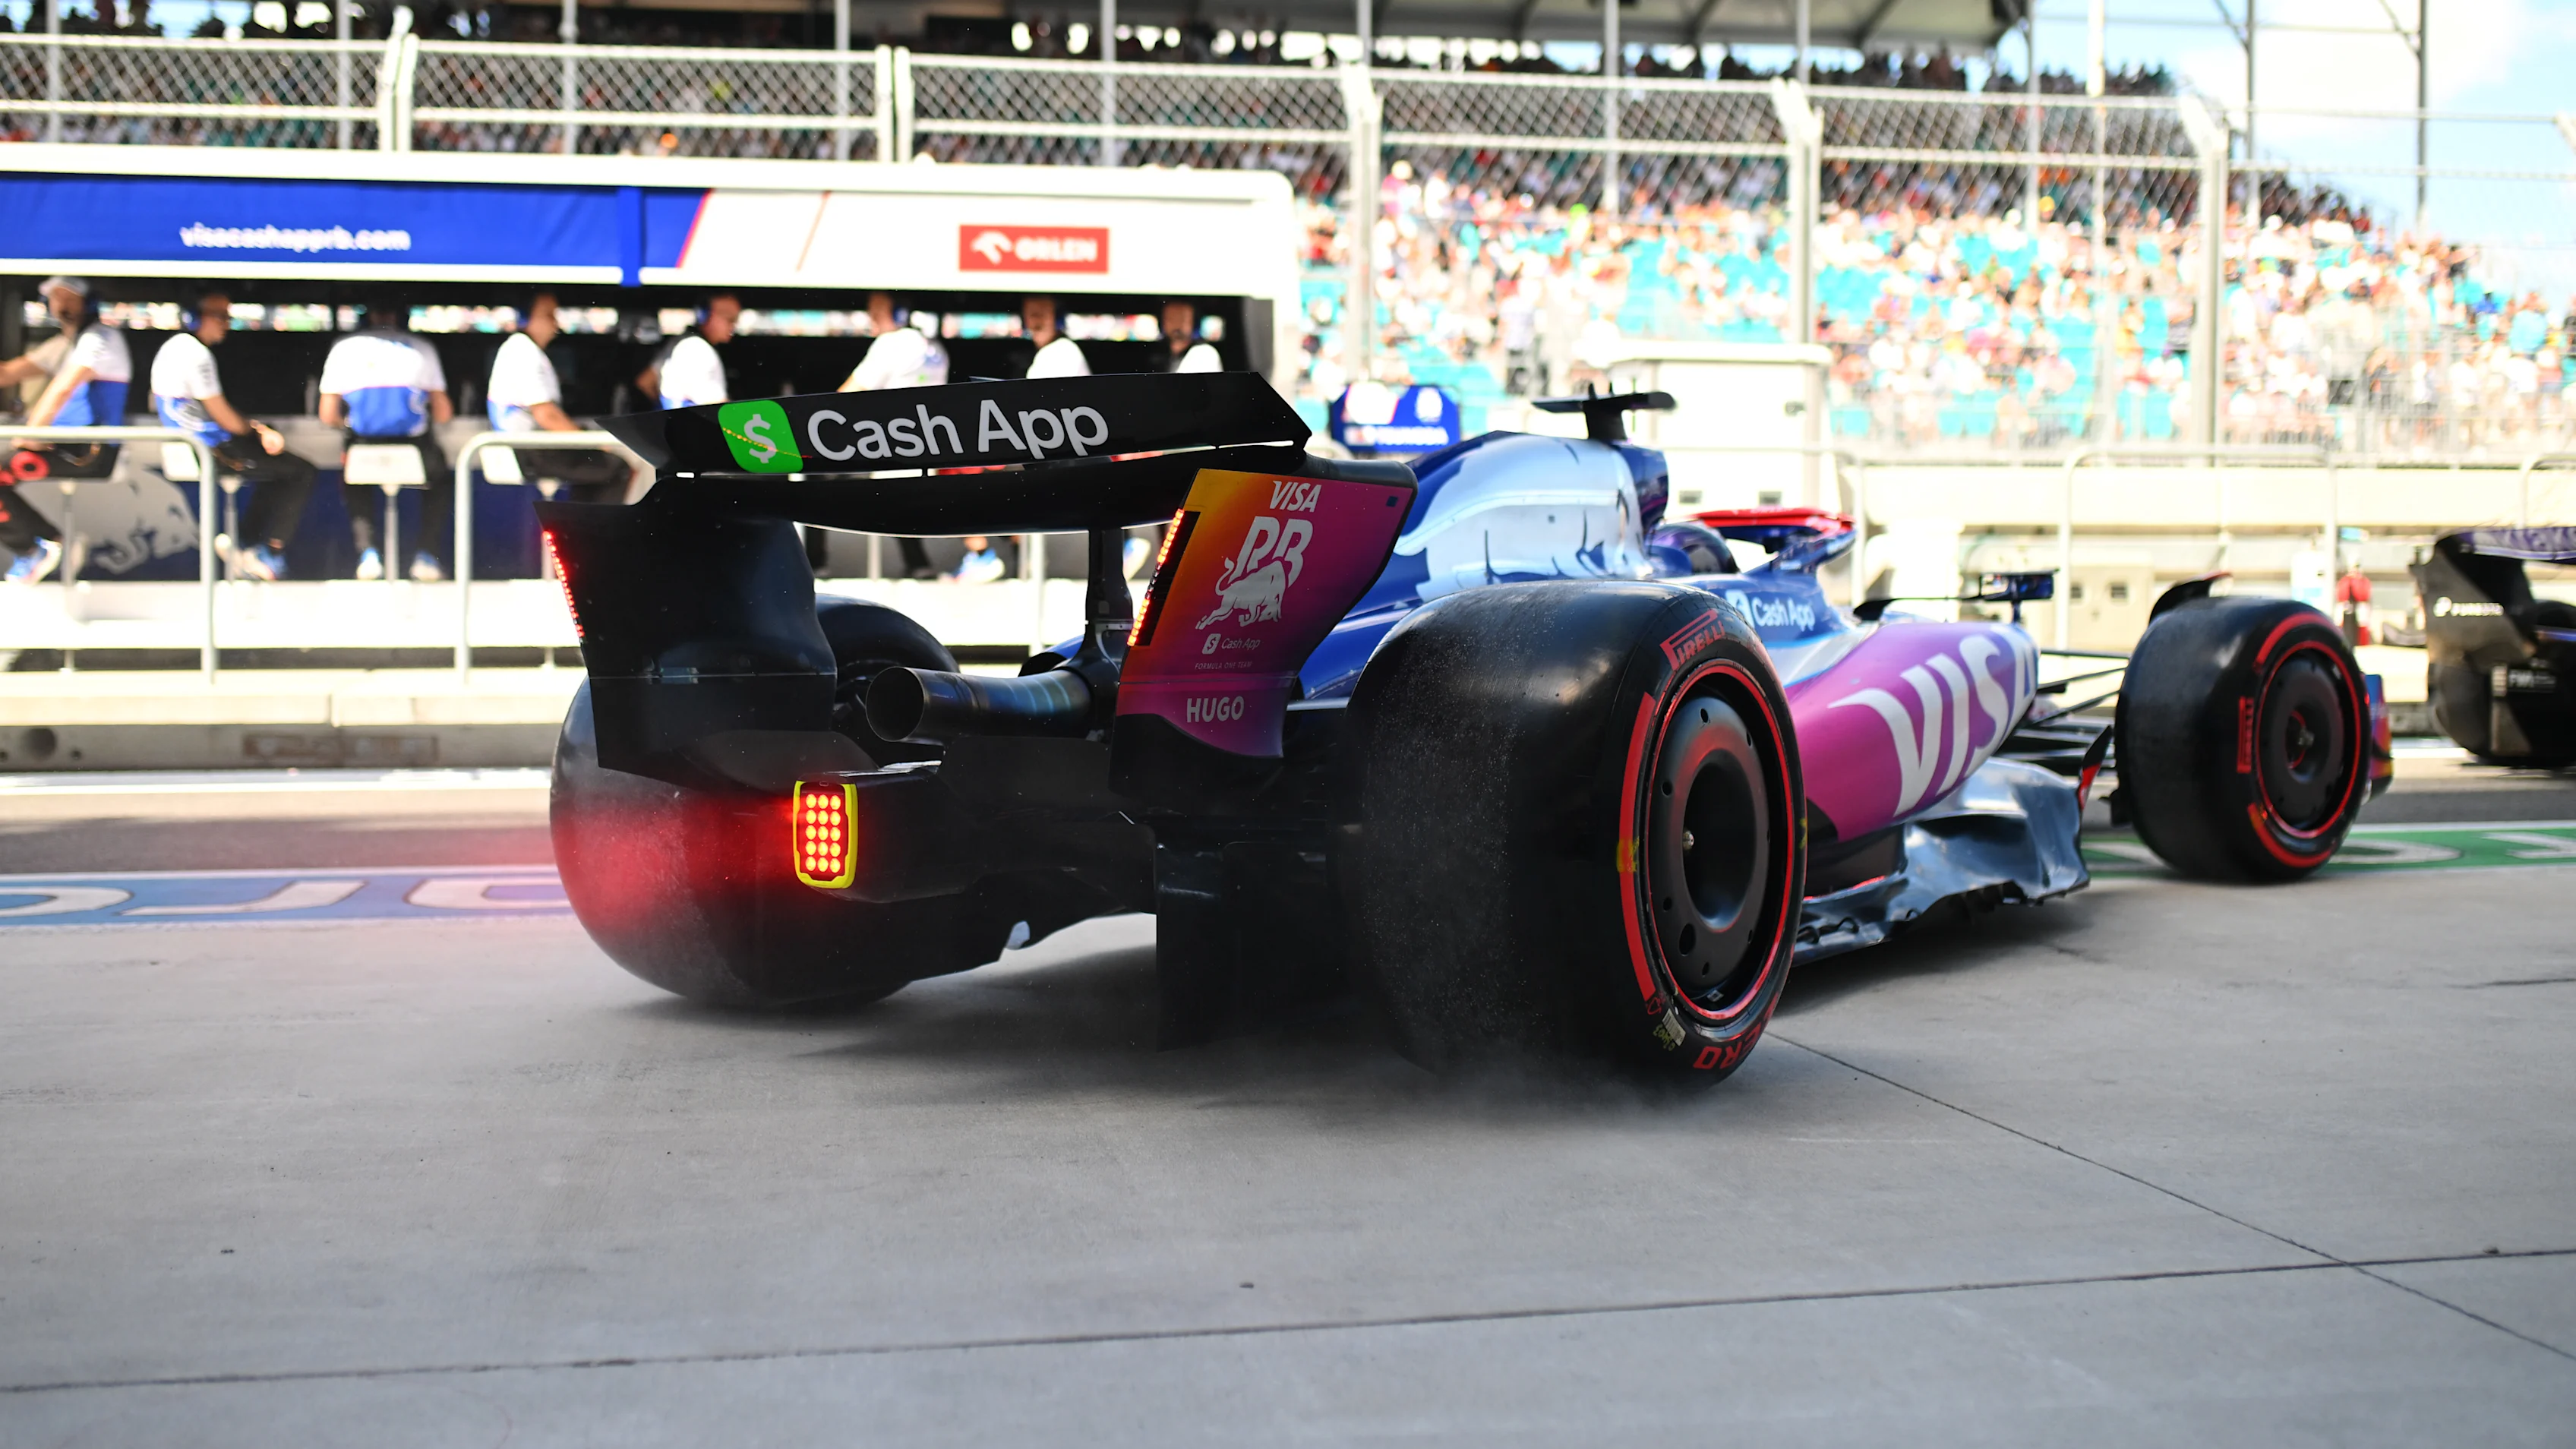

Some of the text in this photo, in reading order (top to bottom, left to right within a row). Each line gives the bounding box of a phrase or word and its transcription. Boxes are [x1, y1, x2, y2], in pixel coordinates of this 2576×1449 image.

[1015, 237, 1097, 261] ORLEN
[807, 403, 964, 461] Cash
[977, 399, 1110, 459] App
[1268, 480, 1322, 513] VISA
[1752, 597, 1816, 632] Cash App
[1221, 637, 1243, 649] Cash
[1242, 637, 1261, 651] App
[1659, 608, 1727, 672] PIRELLI
[1195, 661, 1223, 670] FORMULA
[1186, 696, 1245, 723] HUGO
[1826, 623, 2039, 818] VISA
